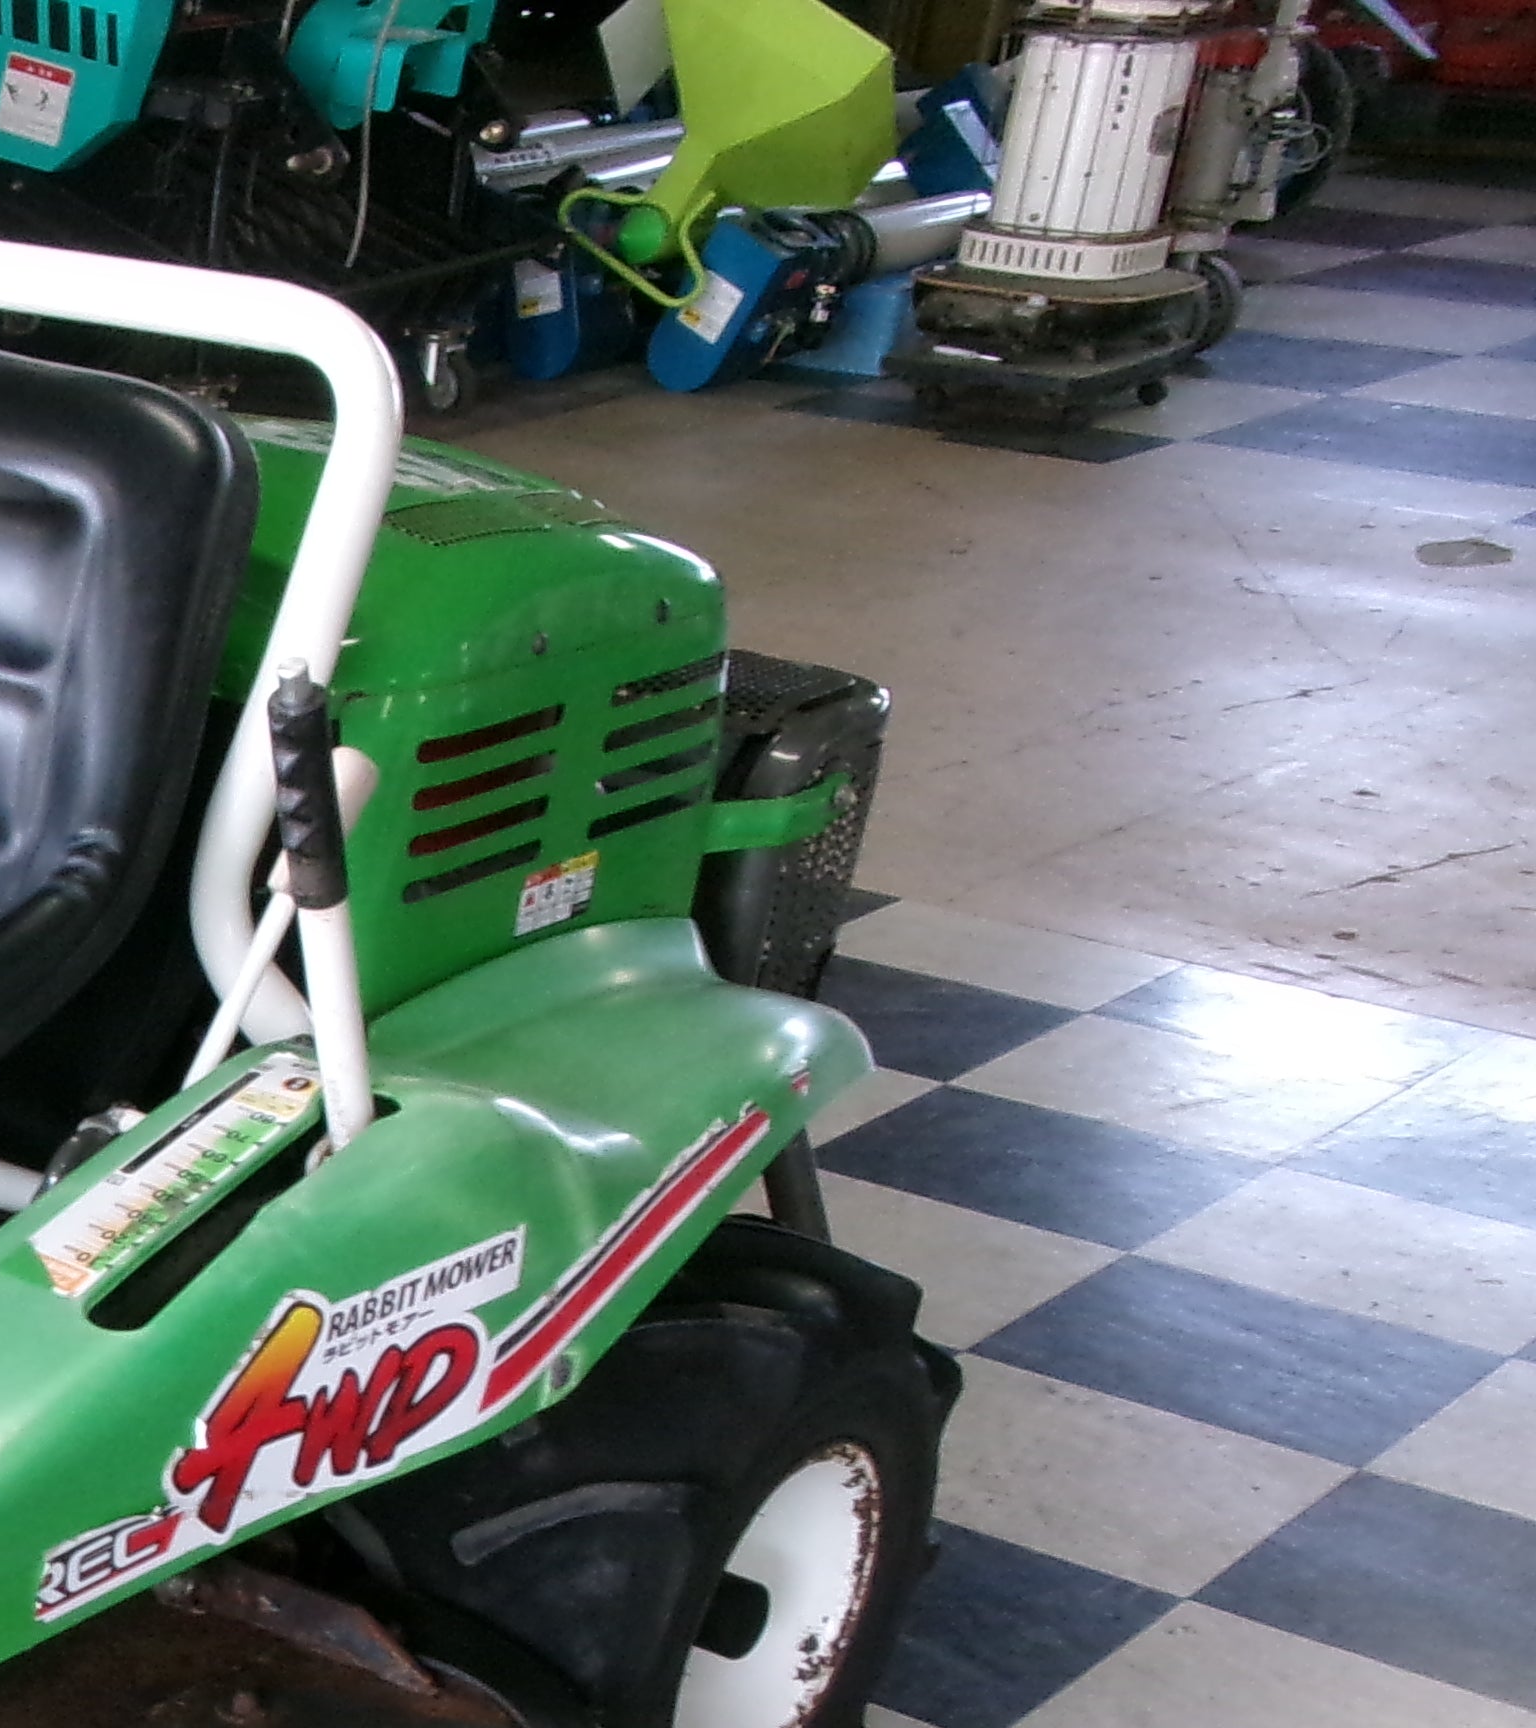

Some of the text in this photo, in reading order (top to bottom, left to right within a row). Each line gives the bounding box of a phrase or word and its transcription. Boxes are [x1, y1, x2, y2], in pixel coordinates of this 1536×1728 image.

[322, 1309, 435, 1365] ラビットモアー
[326, 1237, 518, 1342] RABBIT MOWER
[172, 1298, 480, 1535] 4WD
